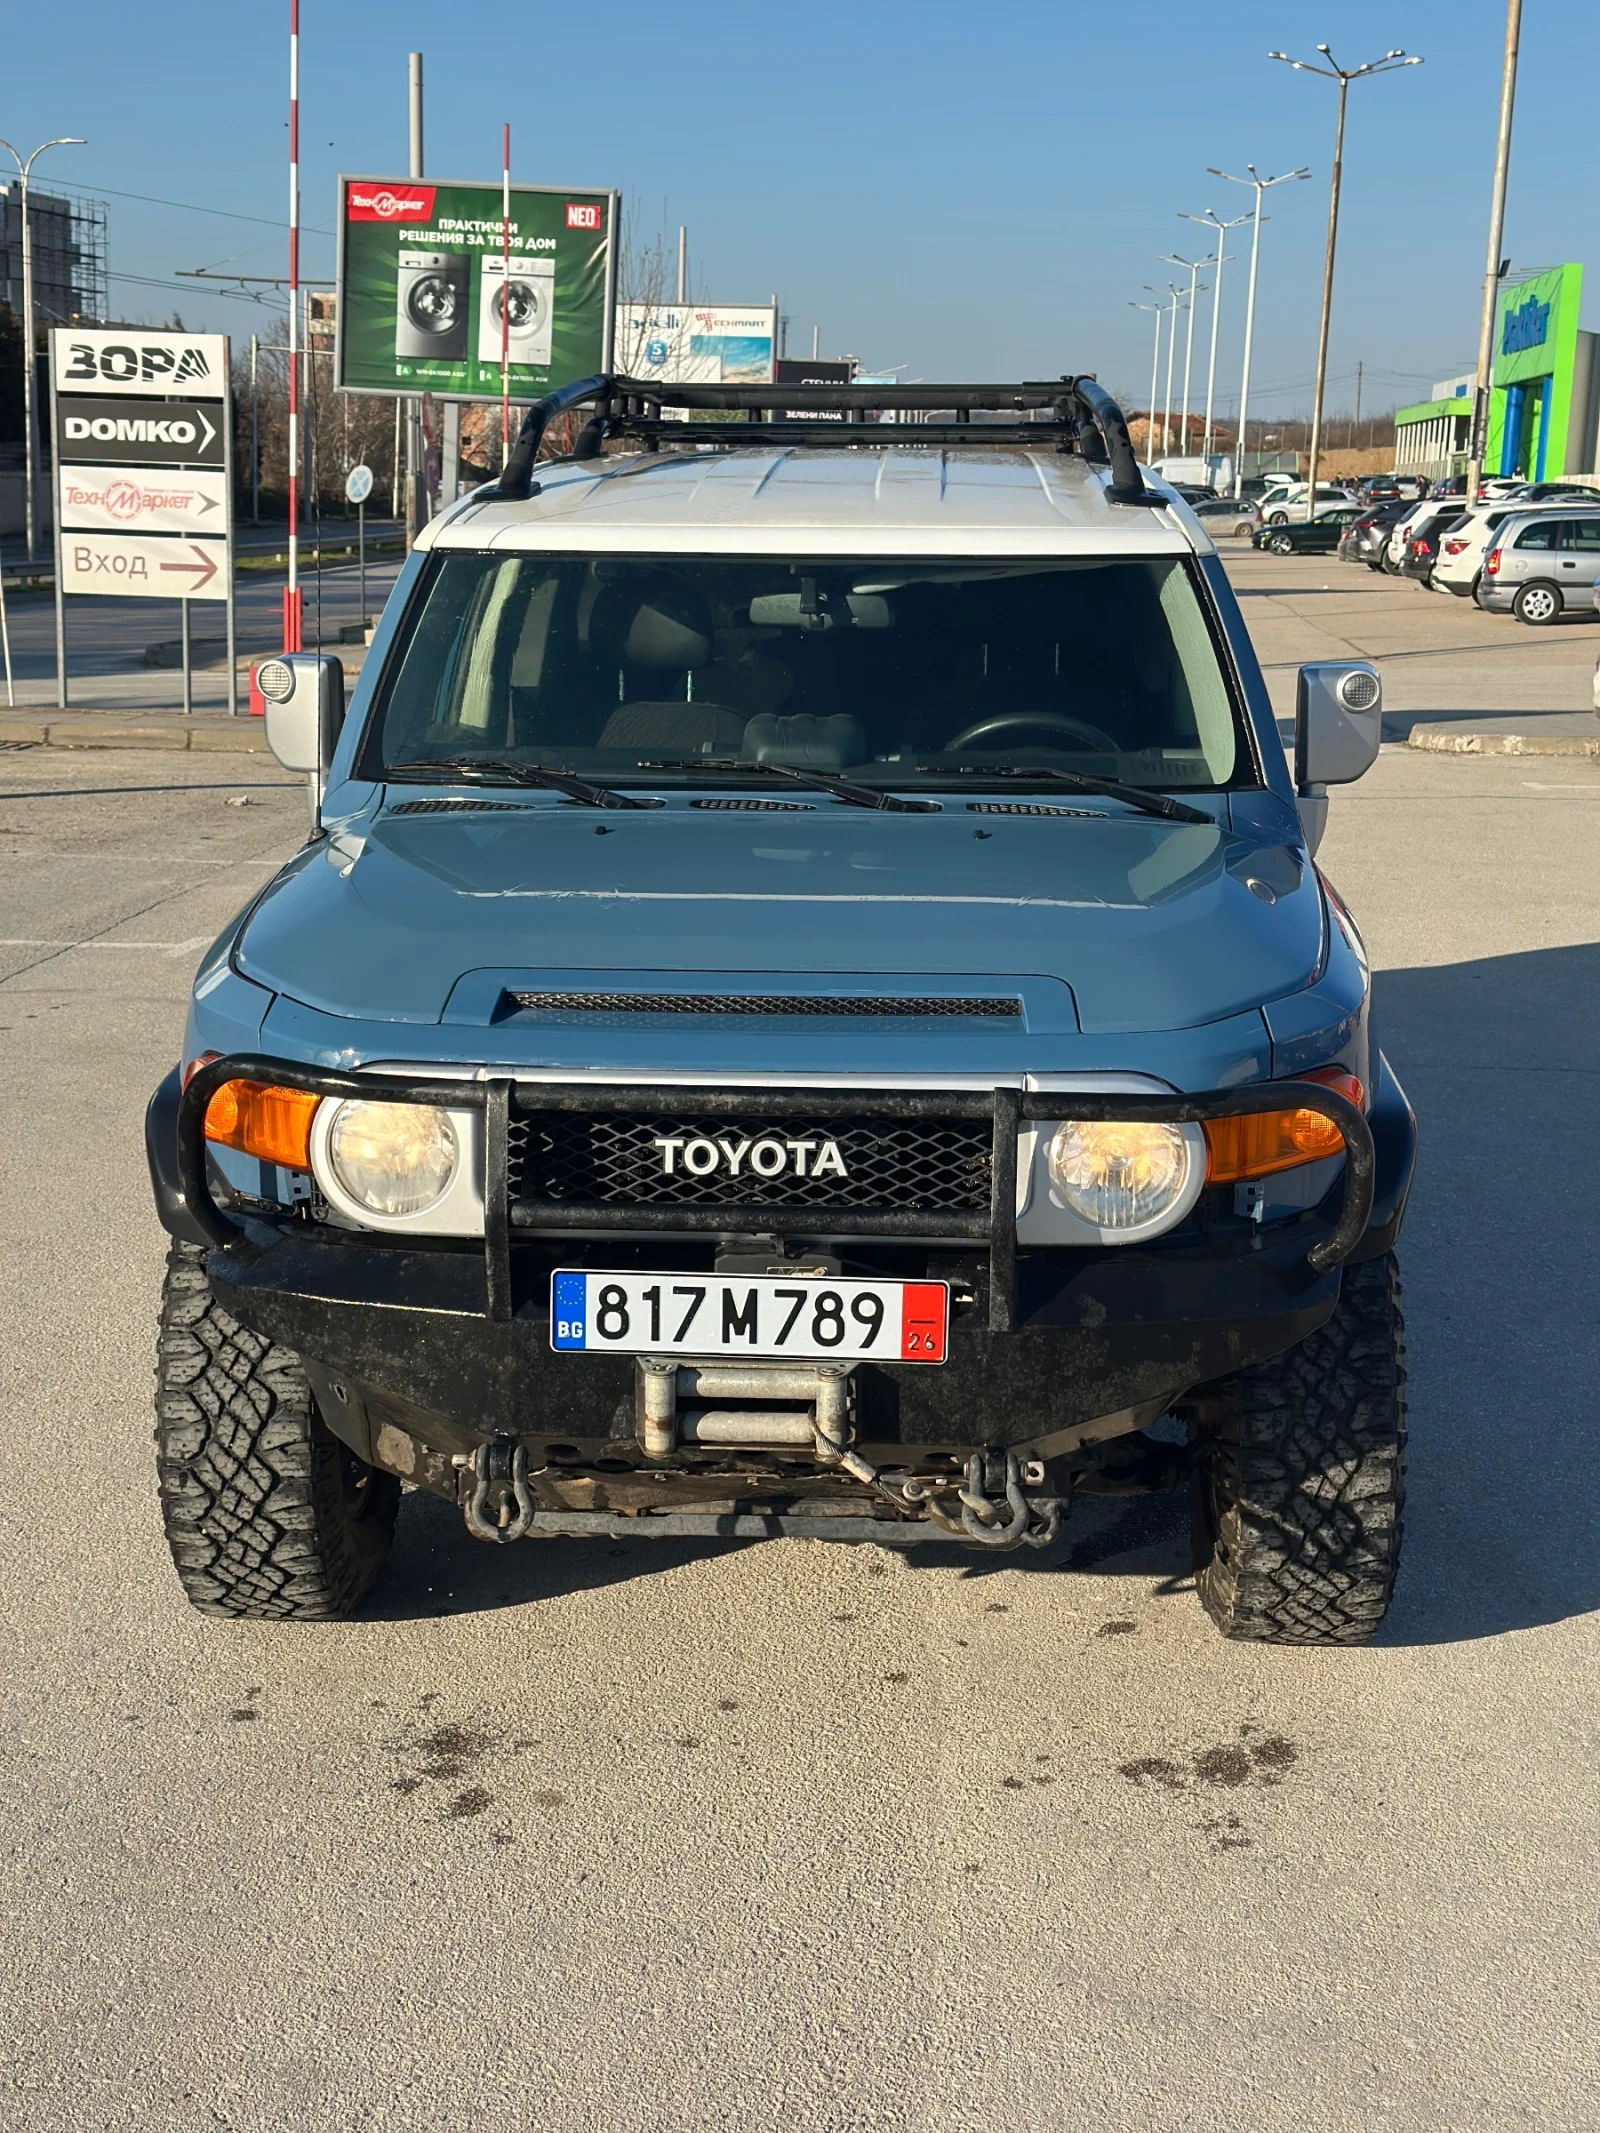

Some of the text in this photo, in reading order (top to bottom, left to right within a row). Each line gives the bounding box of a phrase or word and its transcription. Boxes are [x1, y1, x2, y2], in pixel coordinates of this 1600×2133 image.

[568, 207, 596, 227] NEO
[399, 229, 464, 244] РЕШЕНИЯ
[466, 234, 485, 246] ЗА
[525, 237, 556, 250] ДОМ
[652, 343, 662, 355] 5
[64, 343, 211, 384] ЗОРА
[785, 410, 842, 421] ЗЕЛЕНИ ПАНА
[65, 417, 196, 444] DOMKO
[74, 546, 148, 580] Вход
[654, 1138, 849, 1177] TOYOTA
[558, 1321, 583, 1339] BG
[908, 1331, 935, 1352] 26
